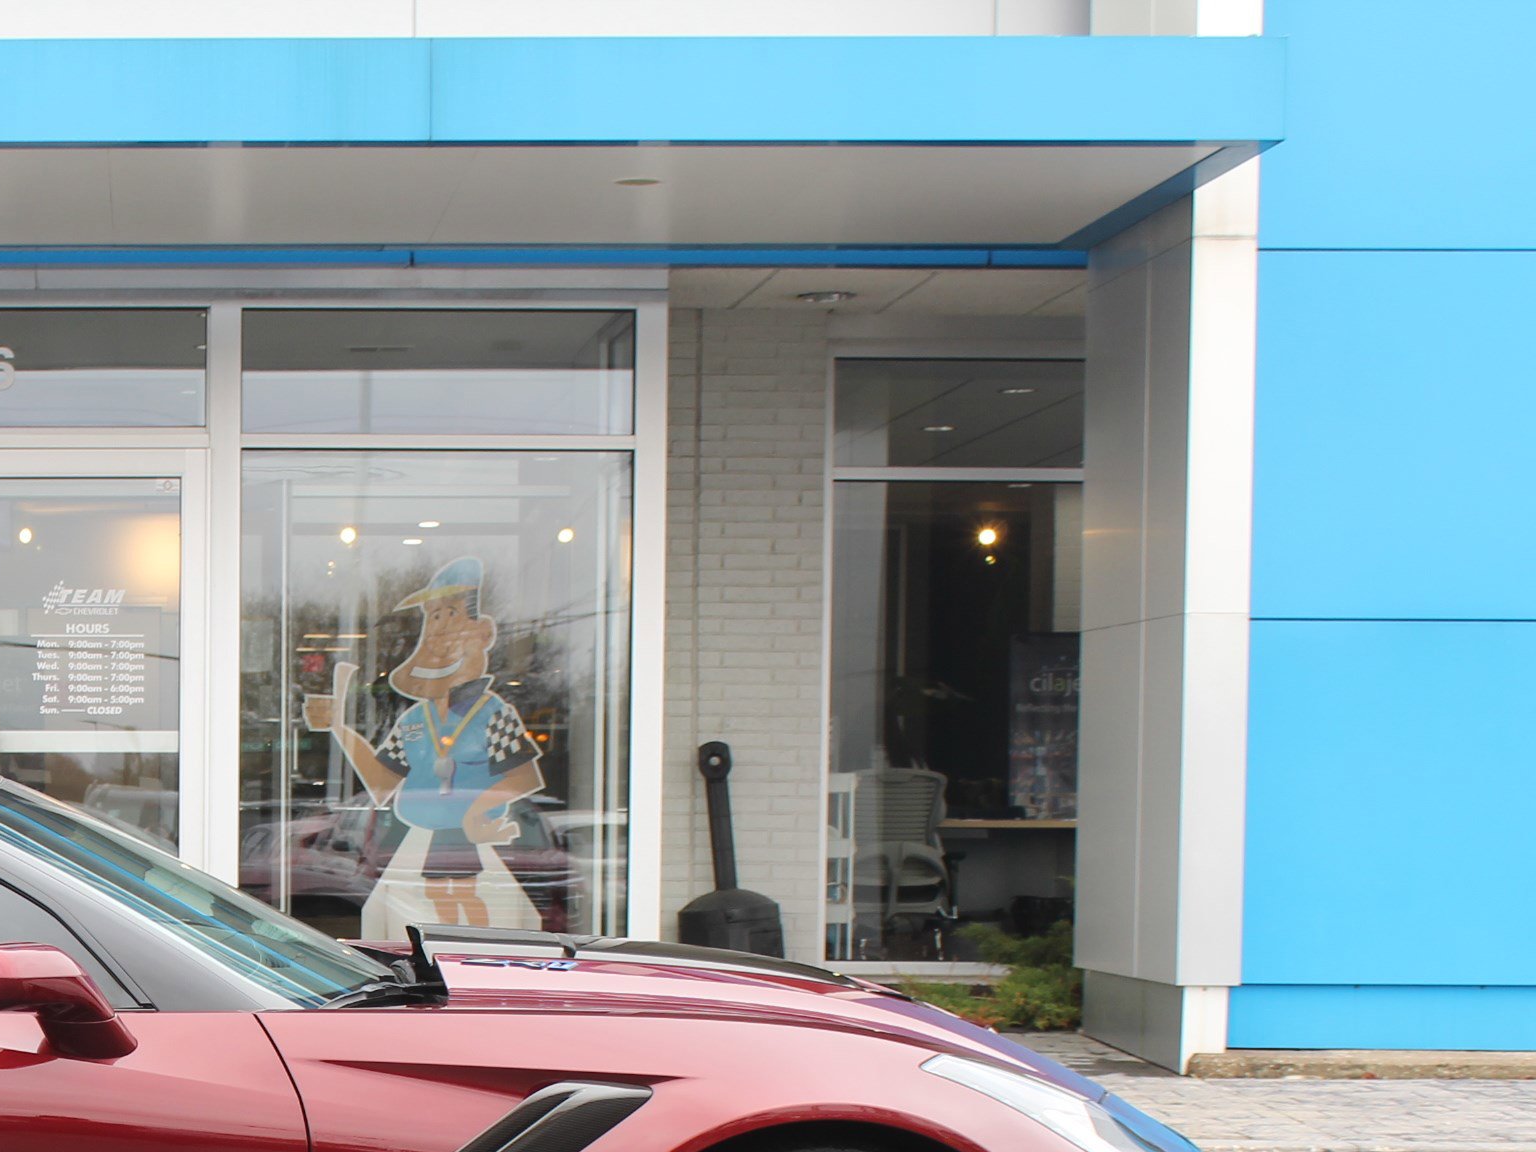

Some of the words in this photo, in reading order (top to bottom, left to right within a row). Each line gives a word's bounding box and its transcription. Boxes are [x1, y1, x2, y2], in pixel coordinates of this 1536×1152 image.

[60, 589, 125, 604] TEAM
[73, 607, 119, 615] CHEVROLET
[65, 623, 110, 634] HOURS
[37, 640, 60, 648] Mon.
[68, 640, 102, 648] 9:00am
[110, 640, 144, 649] 7:00pm
[37, 651, 60, 659] Tues.
[68, 651, 102, 659] 9:00am
[110, 651, 144, 660] 7:00pm
[36, 662, 60, 670] Wed.
[68, 662, 102, 670] 9:00am
[110, 662, 144, 671] 7:00pm
[32, 673, 60, 681] Thurs.
[68, 673, 102, 681] 9:00am
[110, 673, 144, 682] 7:00pm
[45, 684, 60, 692] Fri.
[68, 684, 102, 692] 9:00am
[1029, 672, 1080, 697] cilaje
[42, 695, 60, 703] Sat.
[68, 695, 102, 703] 9:00am
[39, 706, 60, 714] Sun.
[87, 706, 122, 714] CLOSED
